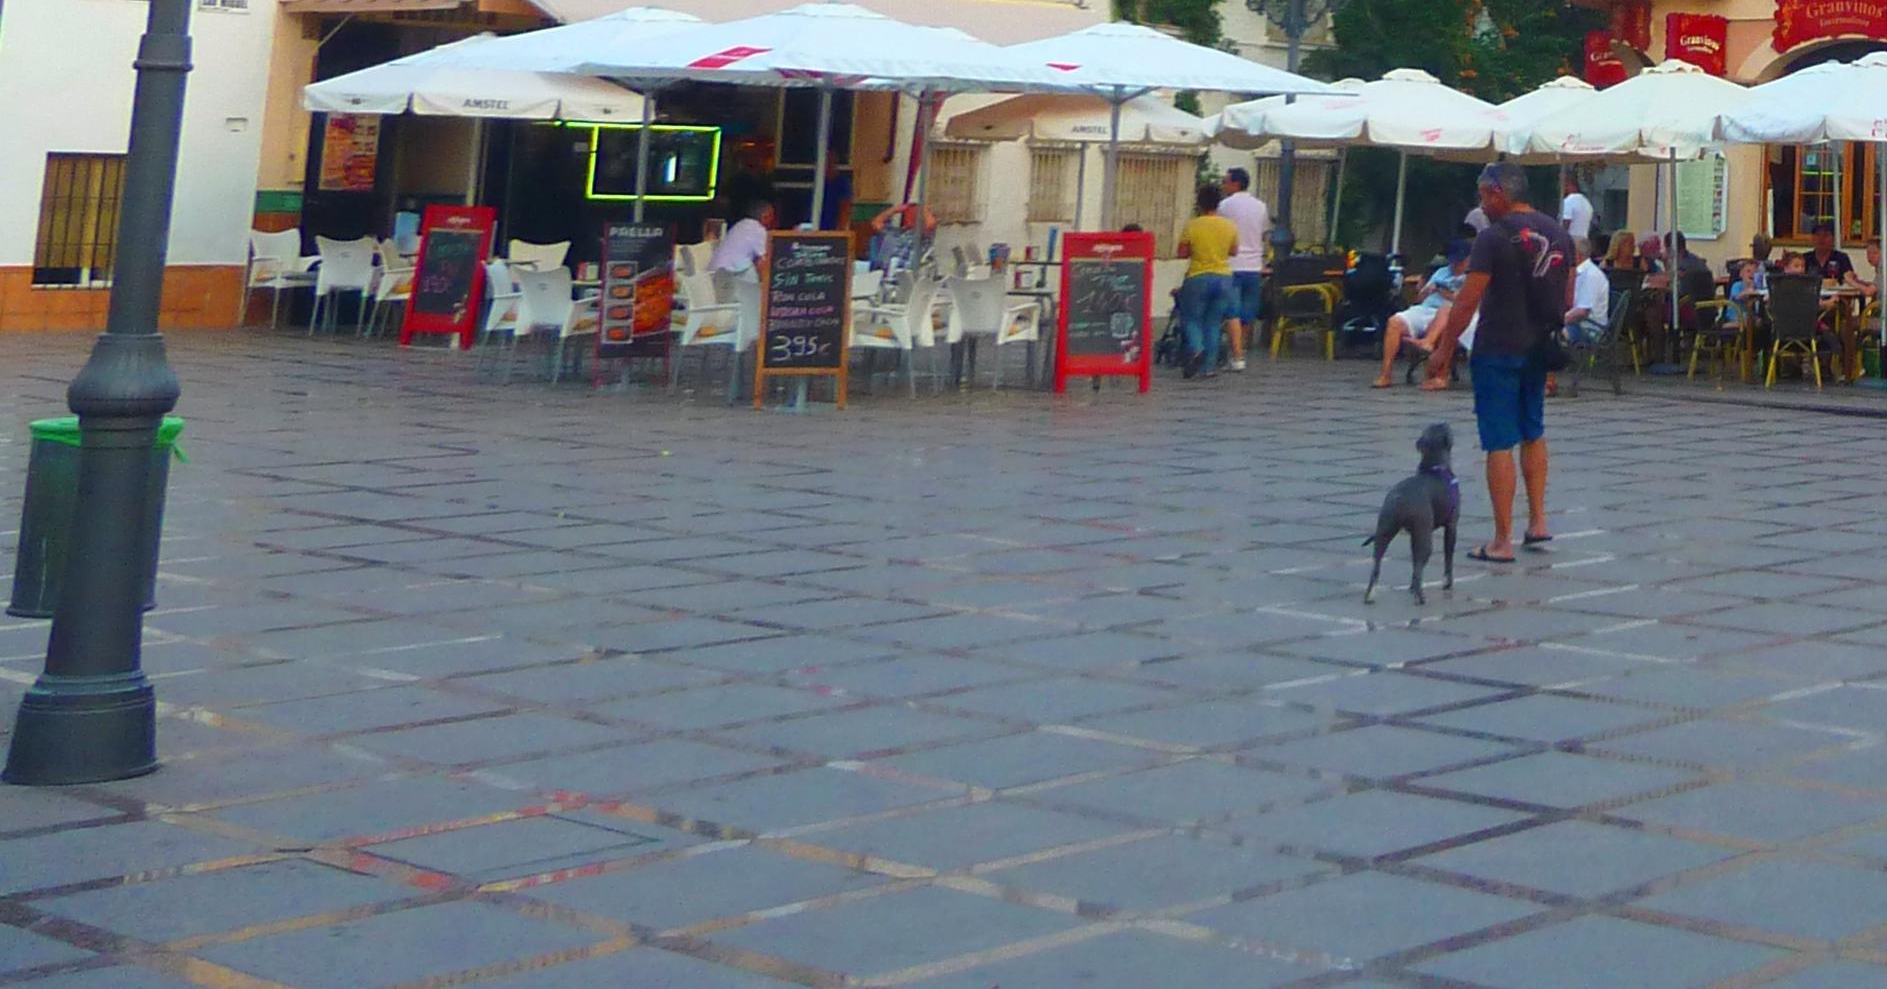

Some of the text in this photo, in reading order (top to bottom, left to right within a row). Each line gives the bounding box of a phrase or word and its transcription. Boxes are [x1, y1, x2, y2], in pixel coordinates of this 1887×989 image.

[1680, 34, 1720, 51] Granvinos
[462, 98, 509, 110] AMSTEL
[1071, 125, 1108, 134] AMSTEL
[609, 227, 664, 237] PAELLA
